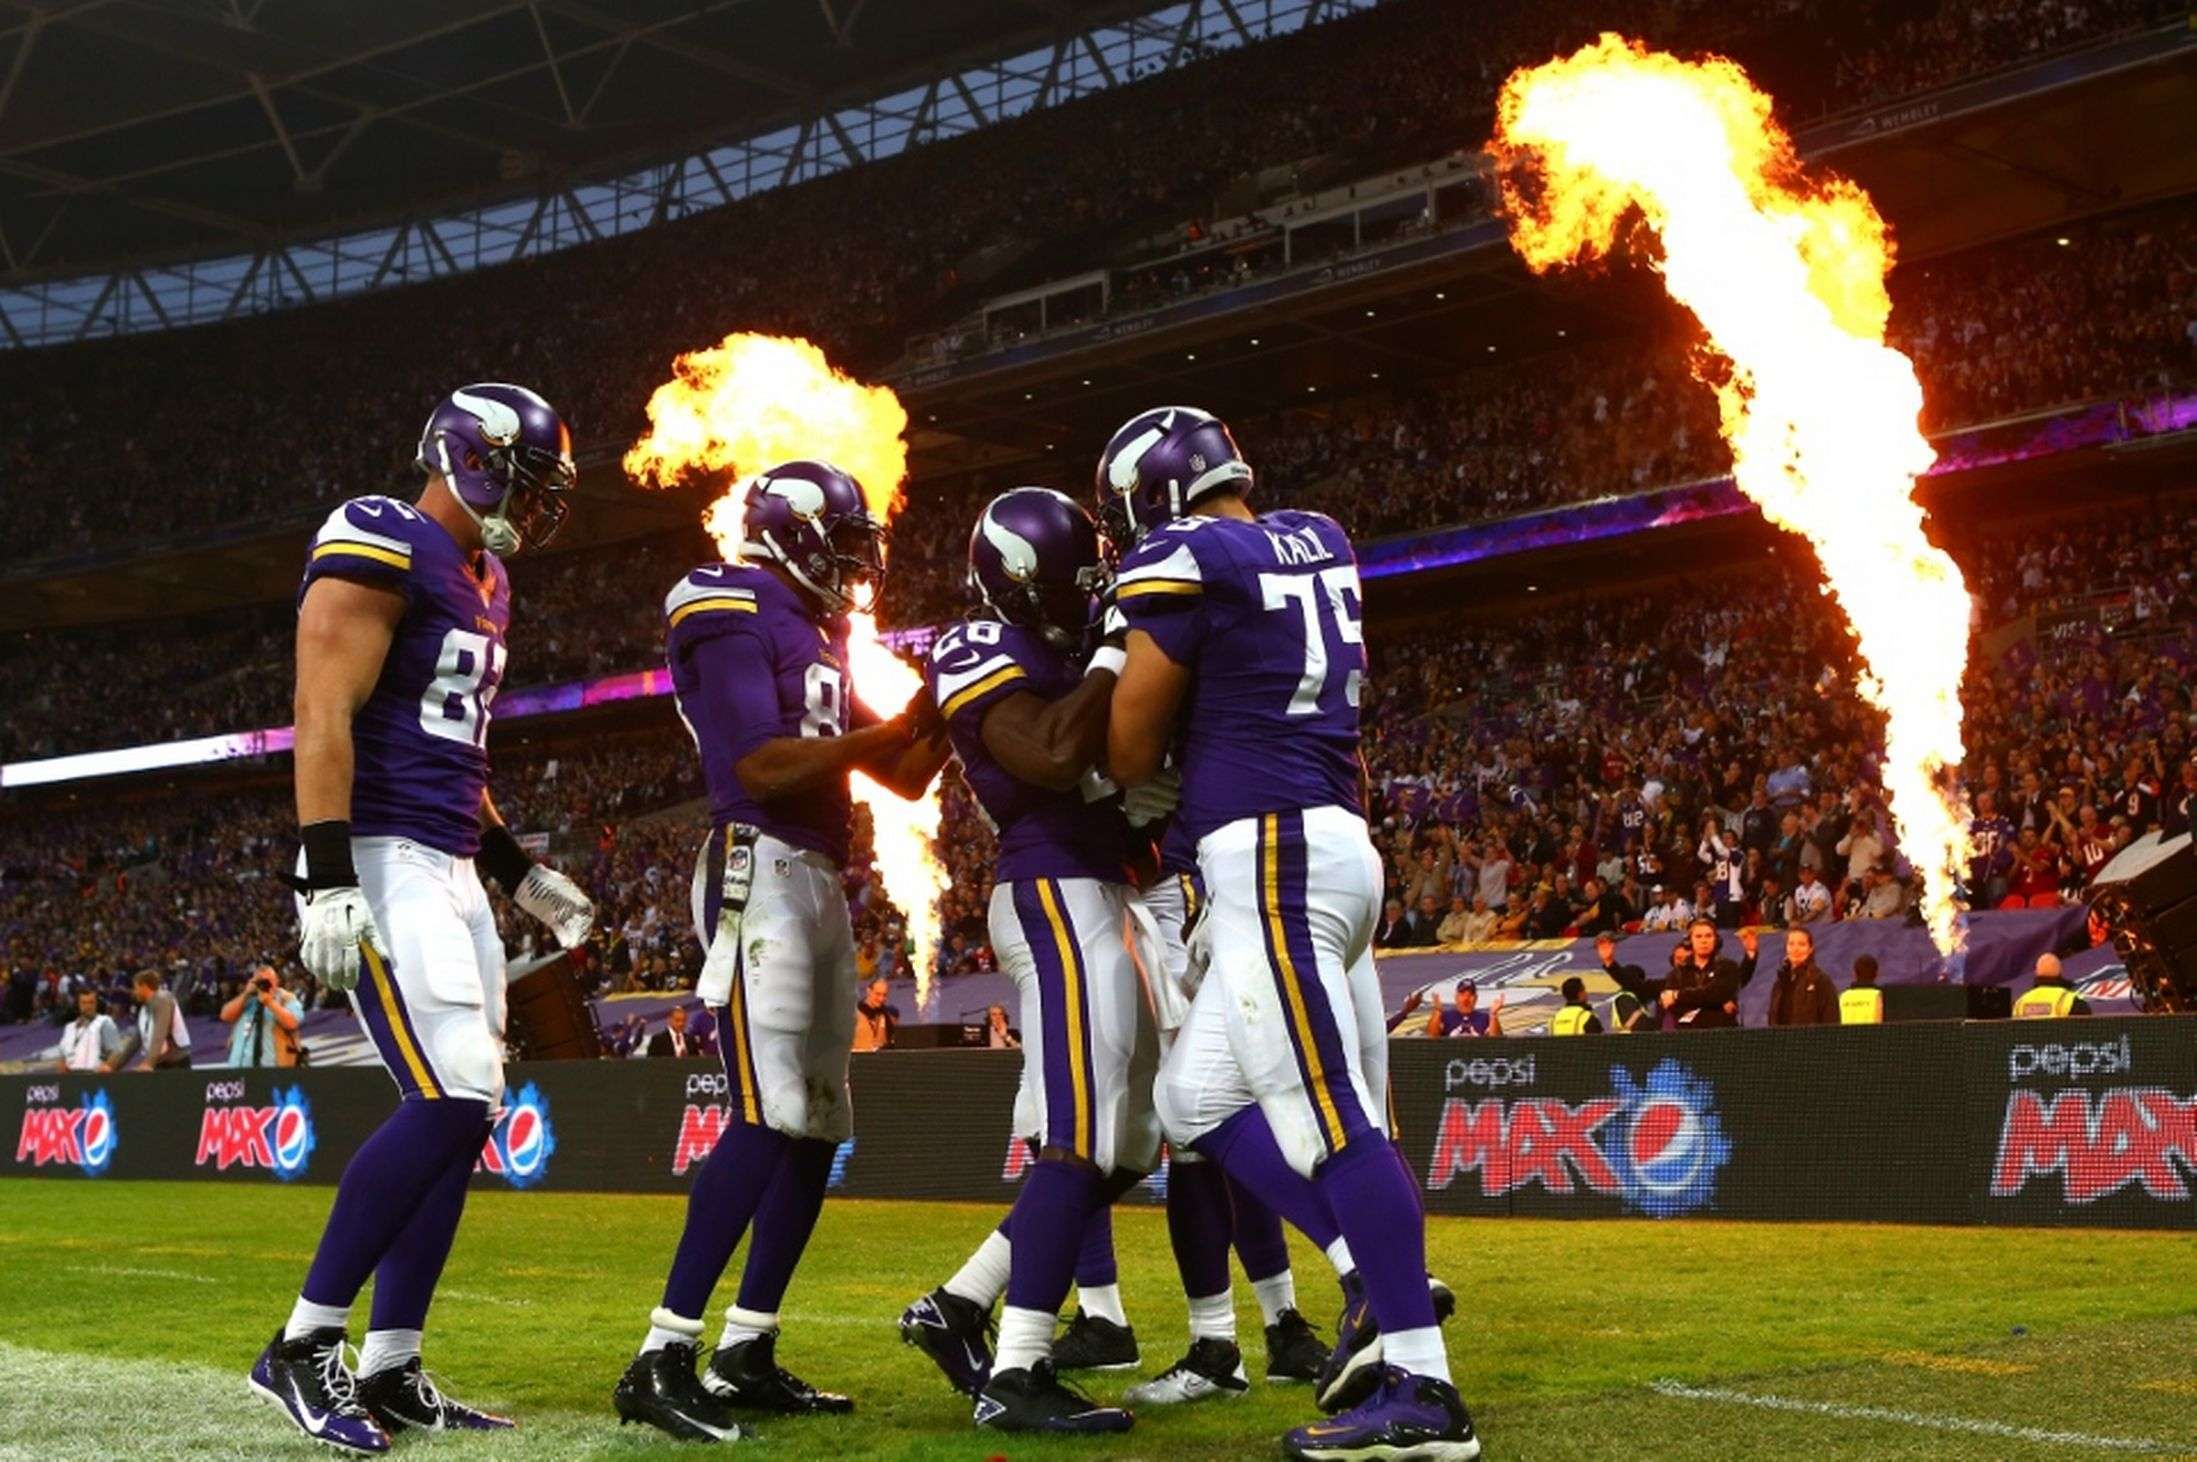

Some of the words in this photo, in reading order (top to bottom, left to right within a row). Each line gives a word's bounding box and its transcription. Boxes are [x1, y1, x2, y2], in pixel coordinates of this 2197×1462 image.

[1880, 104, 1939, 129] WEMBLEY
[800, 662, 850, 737] 8
[1445, 1054, 1536, 1093] pepsi
[2010, 1032, 2133, 1083] pepsi
[26, 1083, 60, 1104] pepsi
[206, 1077, 245, 1103] pepsi
[685, 1072, 729, 1099] pep
[15, 1106, 87, 1168] MAX
[194, 1105, 280, 1171] MAX
[1427, 1096, 1623, 1198] MAX
